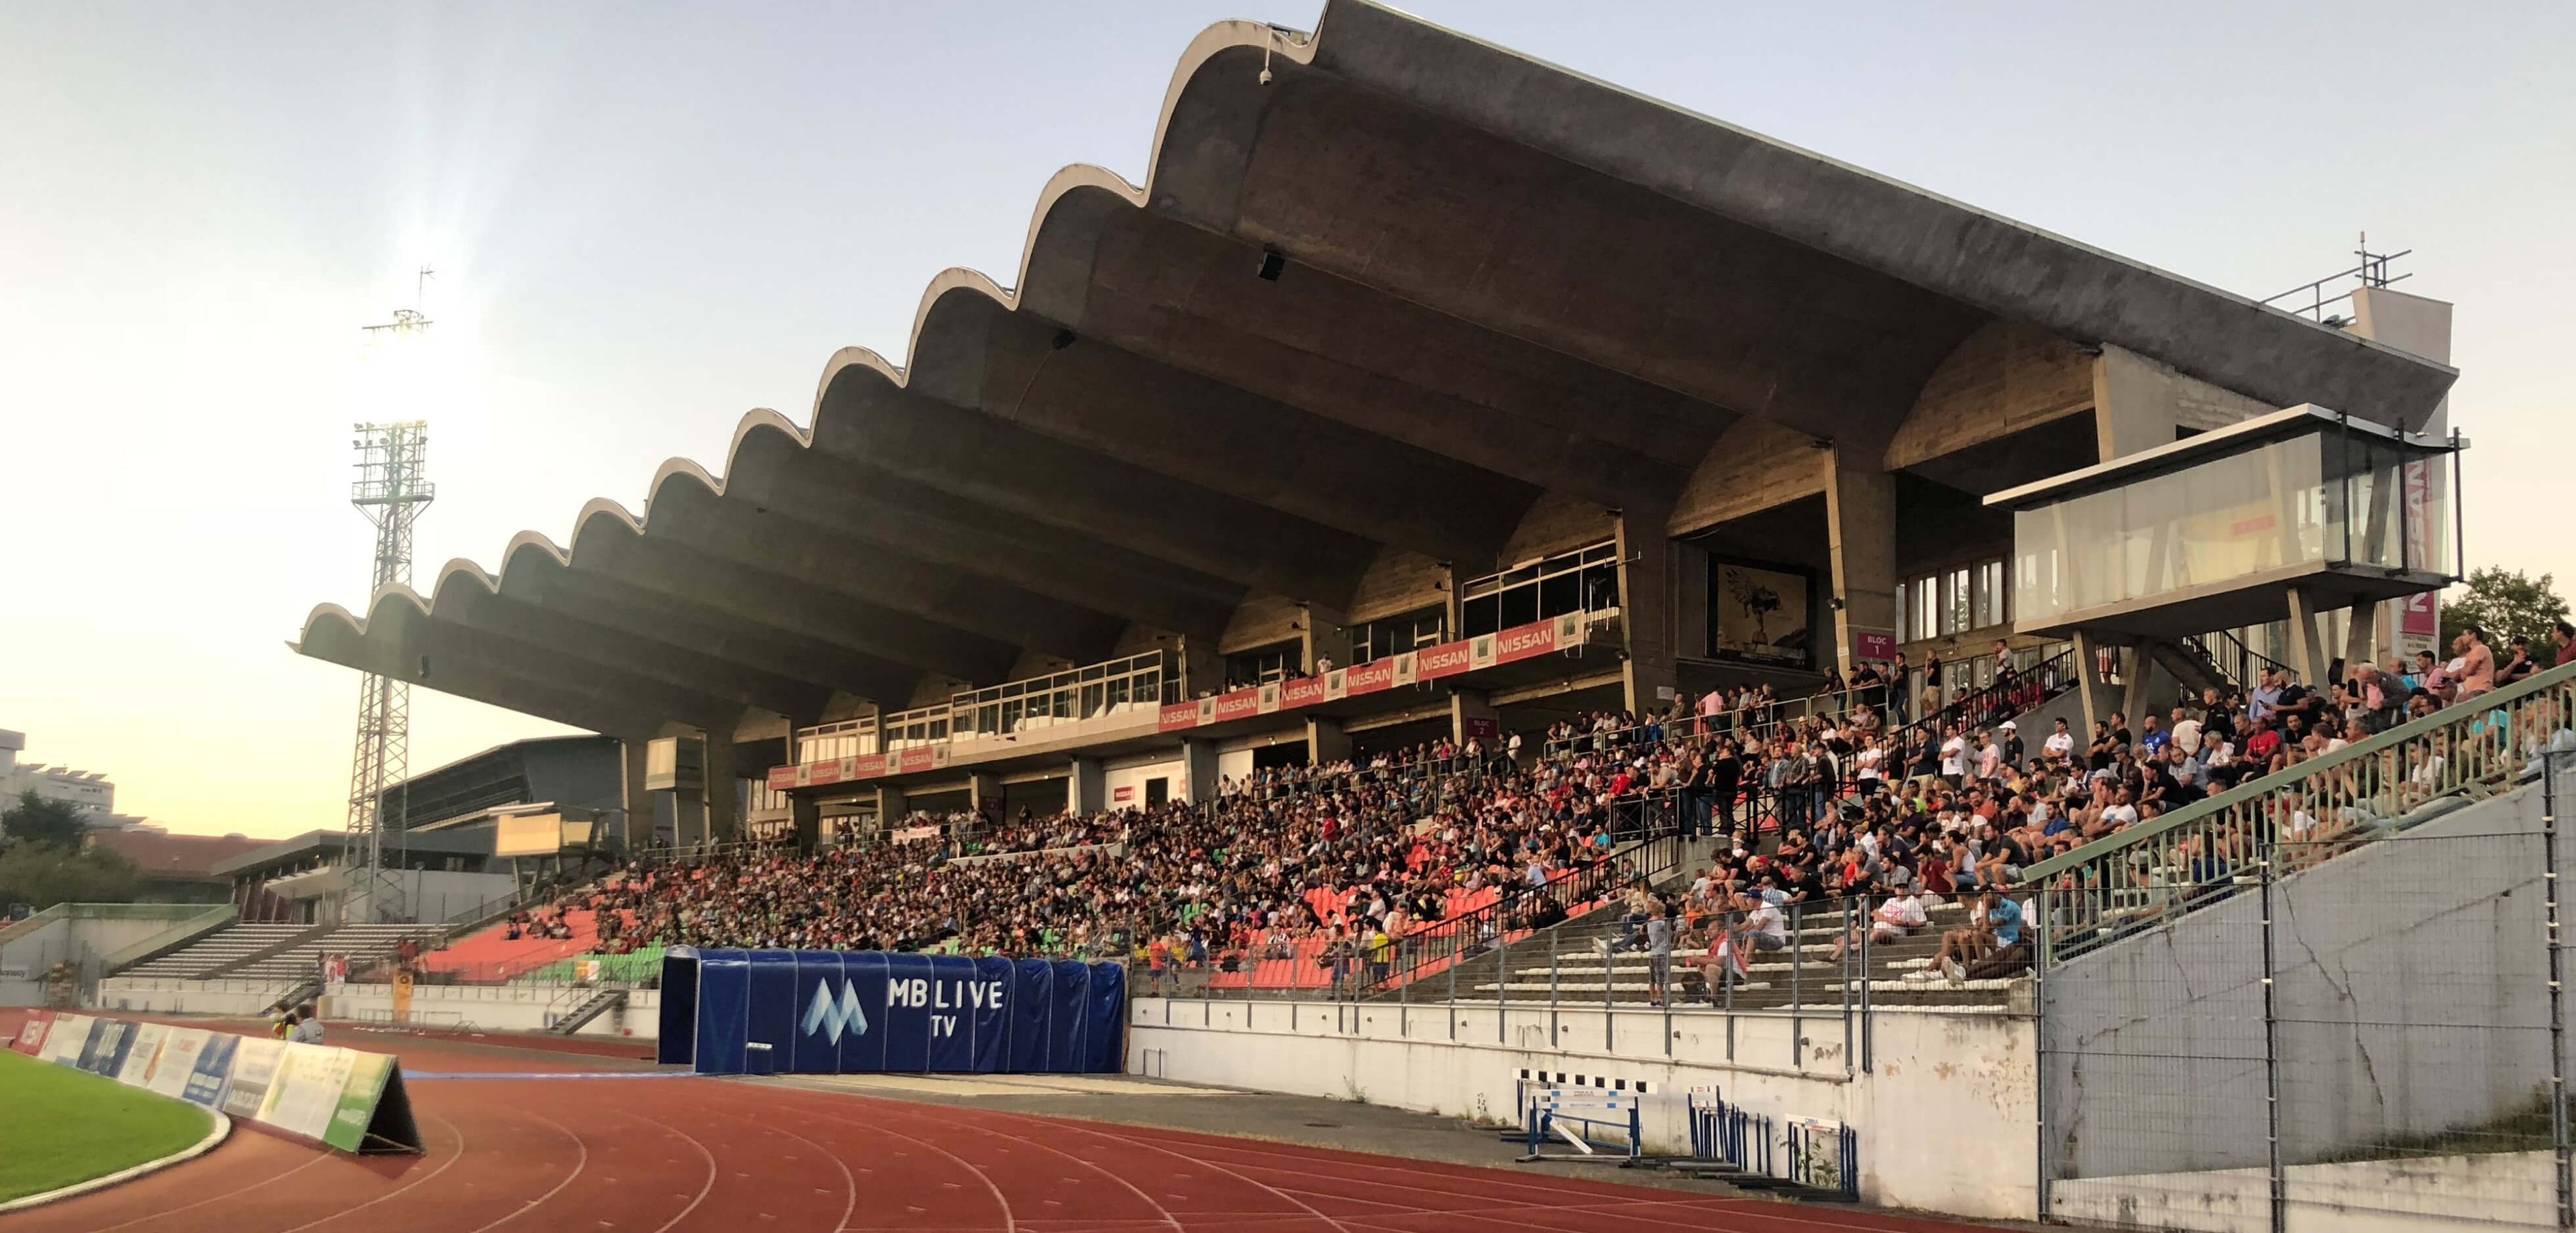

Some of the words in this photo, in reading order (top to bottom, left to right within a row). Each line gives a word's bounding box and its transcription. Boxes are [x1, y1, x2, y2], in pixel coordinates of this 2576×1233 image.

[2408, 460, 2427, 612] NSSAN
[1498, 629, 1552, 655] NISSAN
[1868, 635, 1887, 645] BLOC
[1874, 645, 1879, 655] 1
[1420, 649, 1468, 672] NISSAN
[1348, 667, 1391, 687] NISSAN
[1282, 683, 1324, 701] NISSAN
[1218, 696, 1257, 714] NISSAN
[1161, 708, 1197, 725] NISSAN
[857, 761, 885, 772] NISSAN
[902, 753, 932, 766] NISSAN
[770, 772, 797, 784] NISSAN
[812, 767, 840, 779] NISSAN
[932, 1015, 957, 1037] TV
